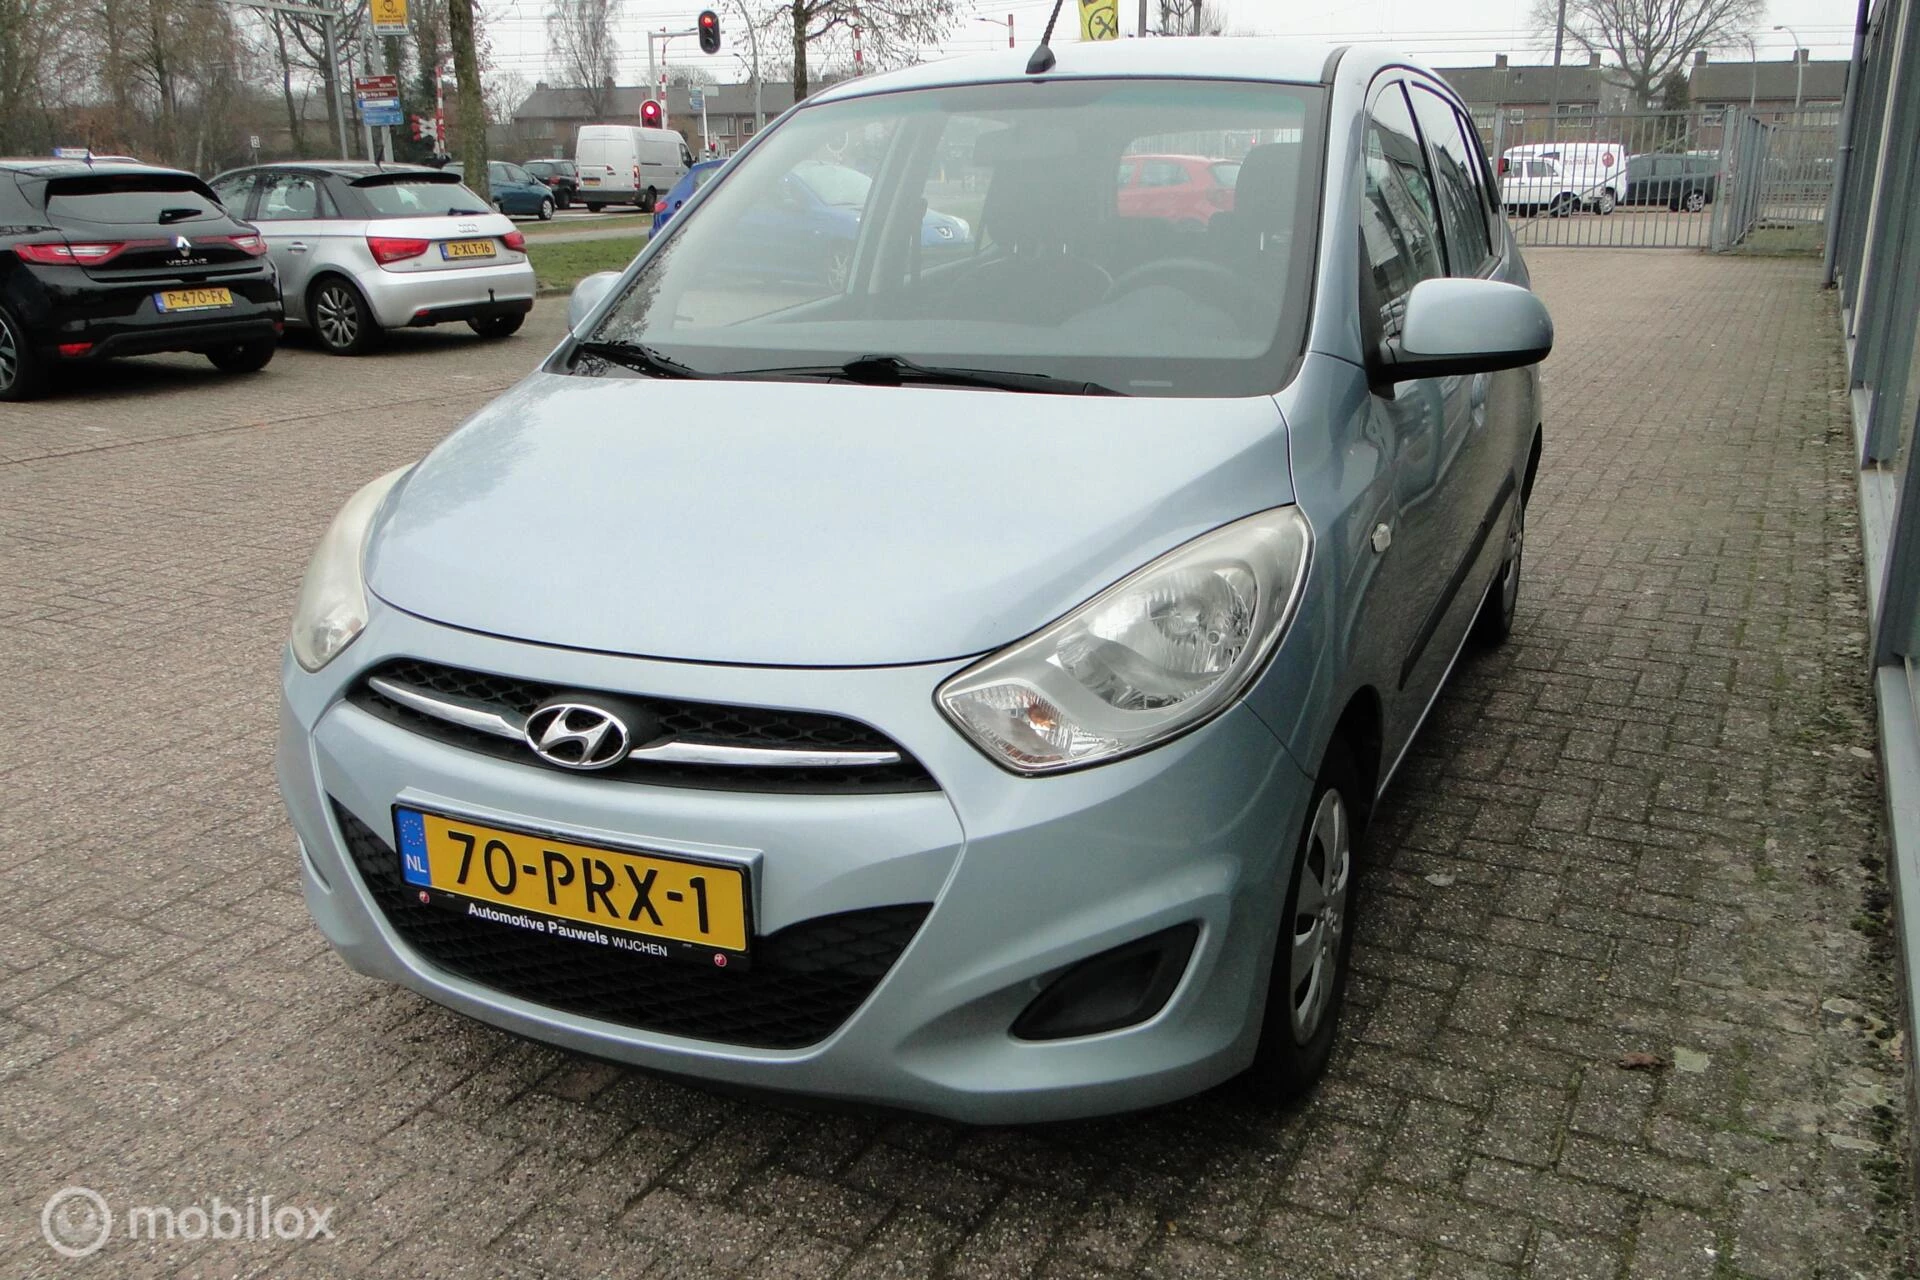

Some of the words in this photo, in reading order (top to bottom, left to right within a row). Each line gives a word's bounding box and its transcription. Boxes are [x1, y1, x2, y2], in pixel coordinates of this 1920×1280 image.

[453, 243, 490, 255] 2-XLT-16
[168, 290, 227, 306] P-470-FK
[405, 853, 427, 873] NL
[447, 830, 710, 934] 70-PRX-1
[468, 902, 545, 932] Automotive
[547, 920, 609, 946] Pauwels
[611, 936, 668, 958] WIJCHEN
